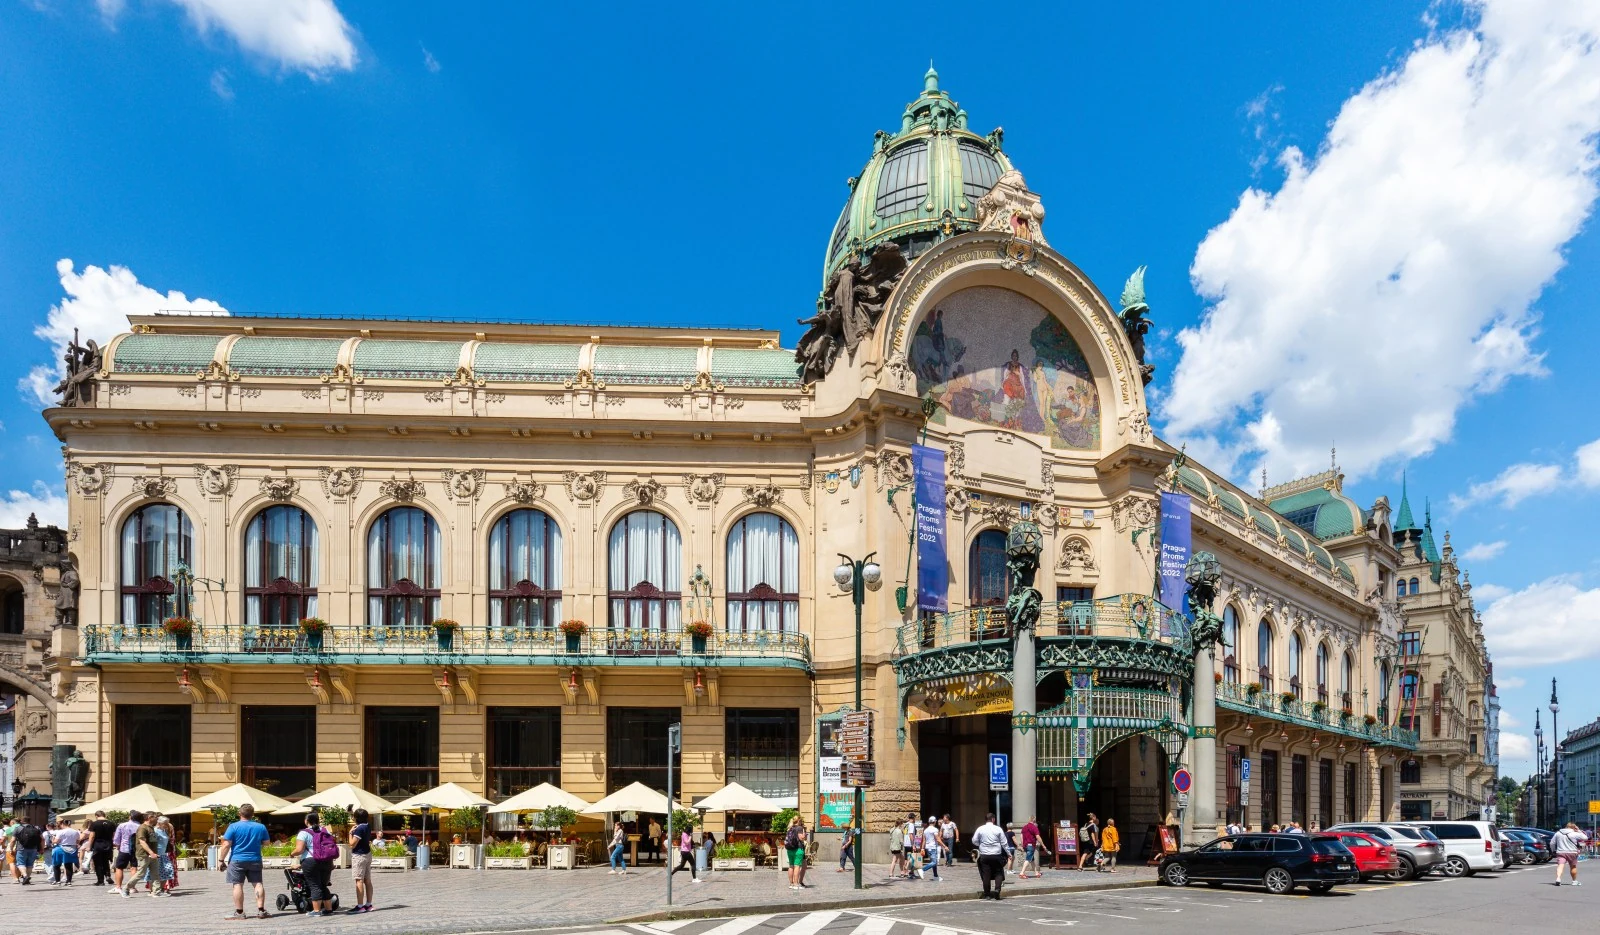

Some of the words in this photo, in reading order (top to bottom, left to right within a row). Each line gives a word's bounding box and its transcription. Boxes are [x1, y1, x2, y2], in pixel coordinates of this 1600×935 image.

[917, 503, 941, 515] Prague
[918, 512, 940, 525] Proms
[919, 522, 943, 535] Festival
[919, 532, 936, 543] 2022
[1162, 543, 1186, 553] Prague
[1162, 552, 1185, 561] Proms
[1162, 560, 1188, 569] Festiva
[1162, 569, 1181, 577] 2022
[986, 689, 1010, 698] ZNOVU
[993, 757, 1004, 775] P
[1243, 761, 1249, 774] P
